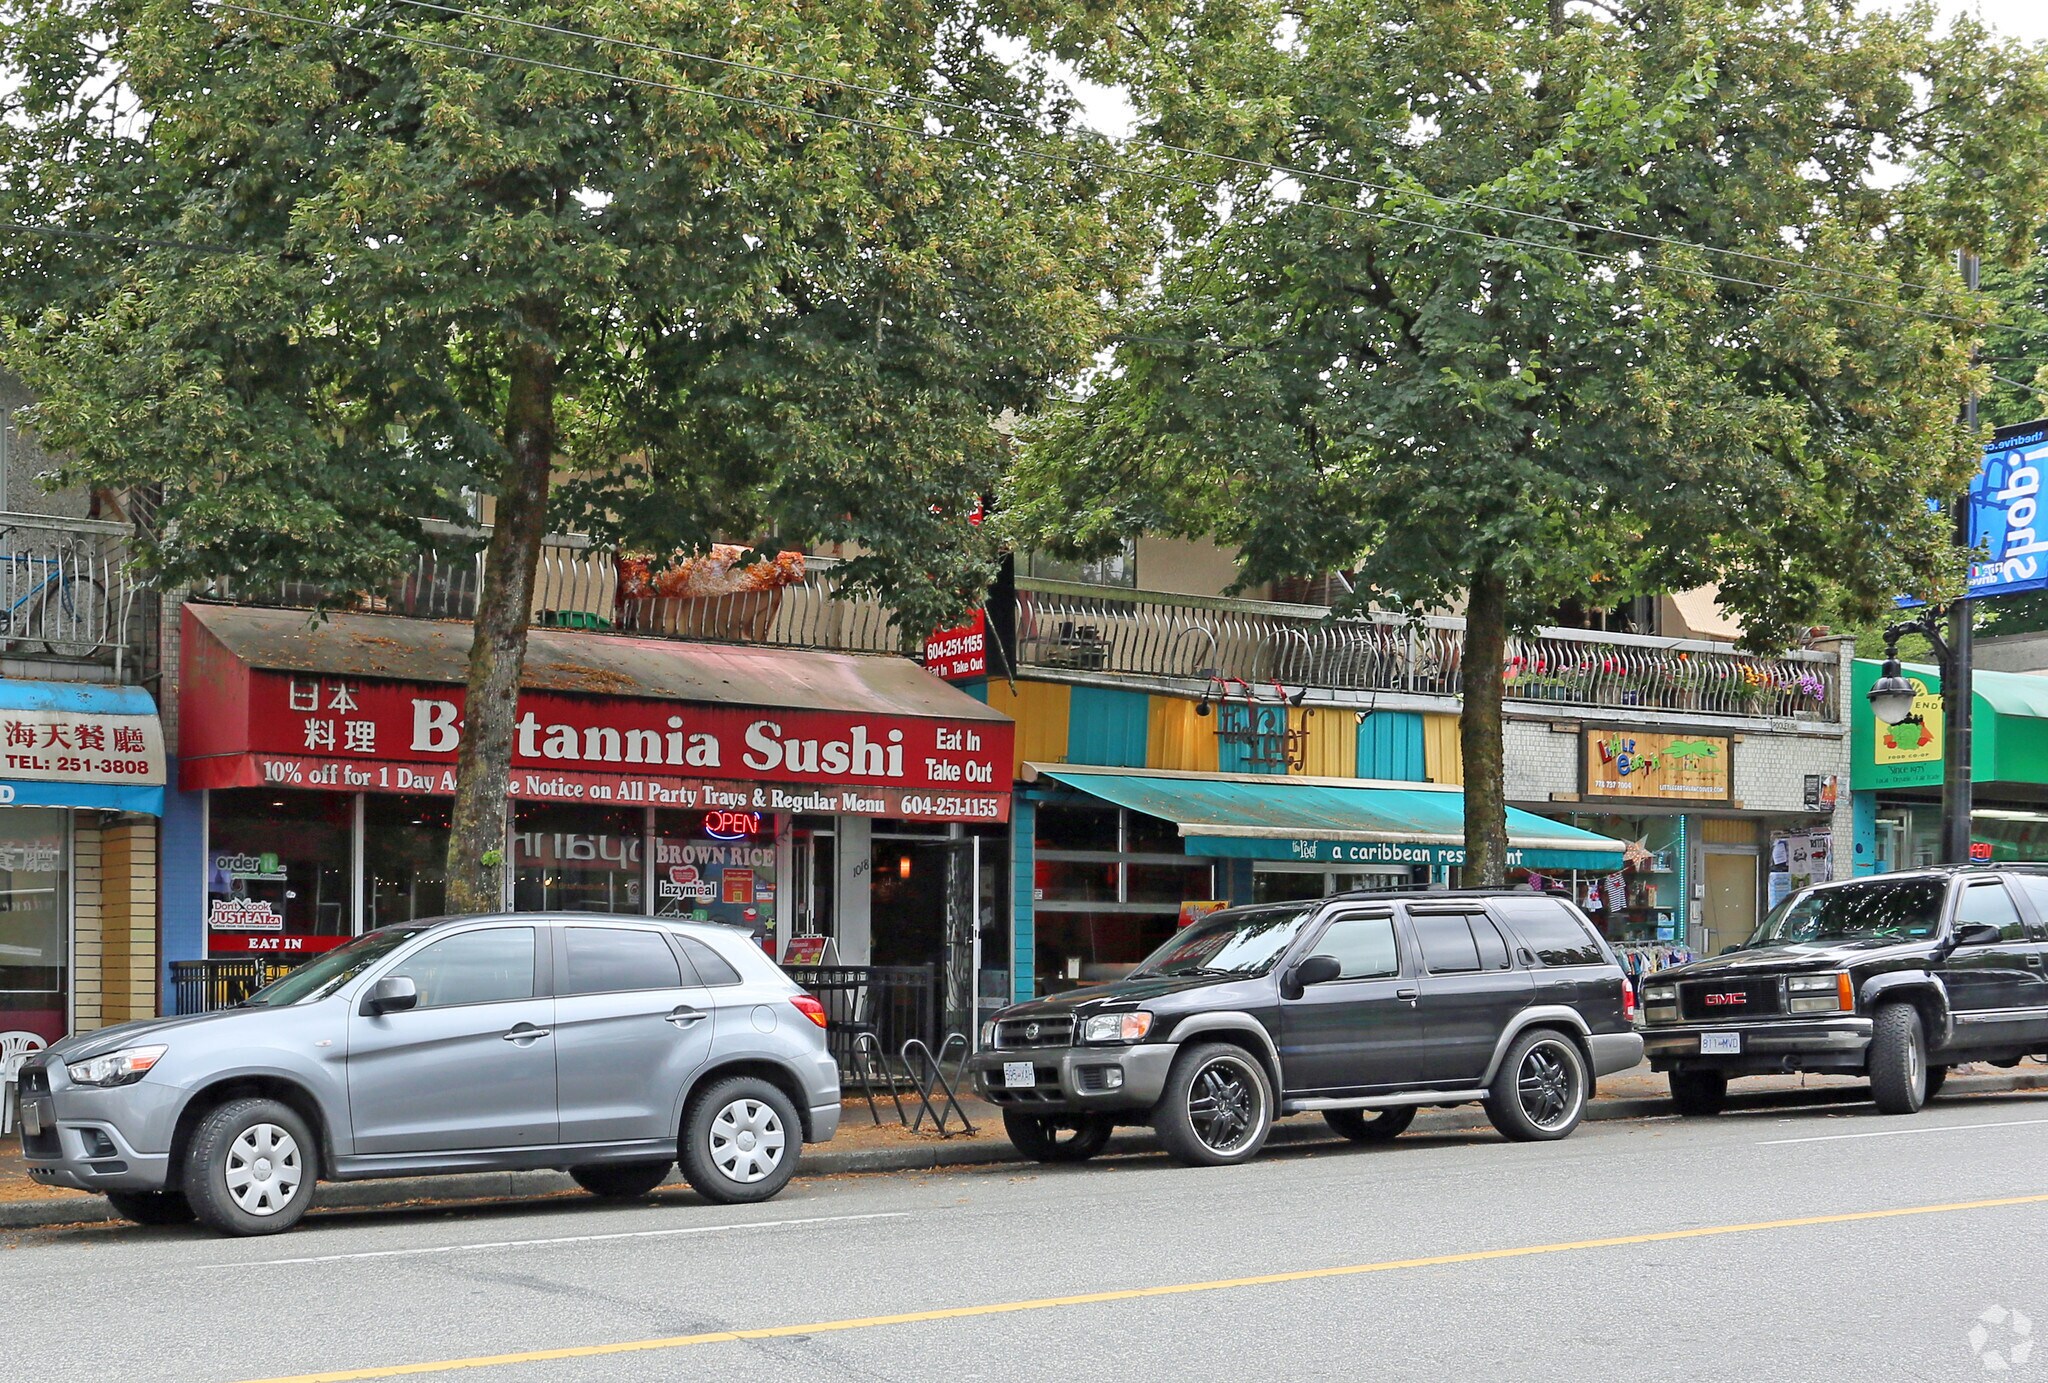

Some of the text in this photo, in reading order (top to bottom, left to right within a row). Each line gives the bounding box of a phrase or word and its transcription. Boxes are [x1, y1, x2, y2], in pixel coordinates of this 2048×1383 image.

[927, 633, 983, 660] 604-251-1155
[940, 664, 948, 677] In
[952, 660, 969, 674] Take
[970, 657, 983, 671] Out
[289, 680, 359, 715] 日本
[1915, 702, 1938, 710] END
[5, 720, 146, 754] 海天餐廳
[304, 718, 376, 753] 料理
[410, 698, 904, 778] Btannia Sushi
[935, 727, 981, 752] Eat In
[5, 754, 149, 774] TEL: 251-3808
[925, 758, 993, 784] Take Out
[263, 760, 302, 784] 10%
[308, 764, 338, 785] off
[343, 764, 372, 787] for
[379, 766, 389, 788] 1
[396, 768, 435, 794] Day
[526, 775, 584, 798] Notice
[589, 783, 612, 799] on
[616, 781, 644, 801] All
[648, 783, 697, 808] Party
[702, 785, 747, 809] Trays
[751, 787, 767, 808] &
[771, 789, 838, 813] Regular
[841, 793, 885, 813] Menu
[900, 795, 998, 817] 604-251-1155
[705, 811, 759, 835] OPEN
[217, 853, 260, 870] order
[655, 845, 726, 866] BROWN
[731, 848, 774, 868] RICE
[1332, 846, 1343, 859] a
[1349, 843, 1431, 862] caribbean
[1438, 848, 1523, 865] resnt
[1969, 843, 1993, 859] PEN
[246, 902, 269, 910] cook
[248, 938, 302, 949] EAT IN
[1704, 992, 1747, 1006] GMC
